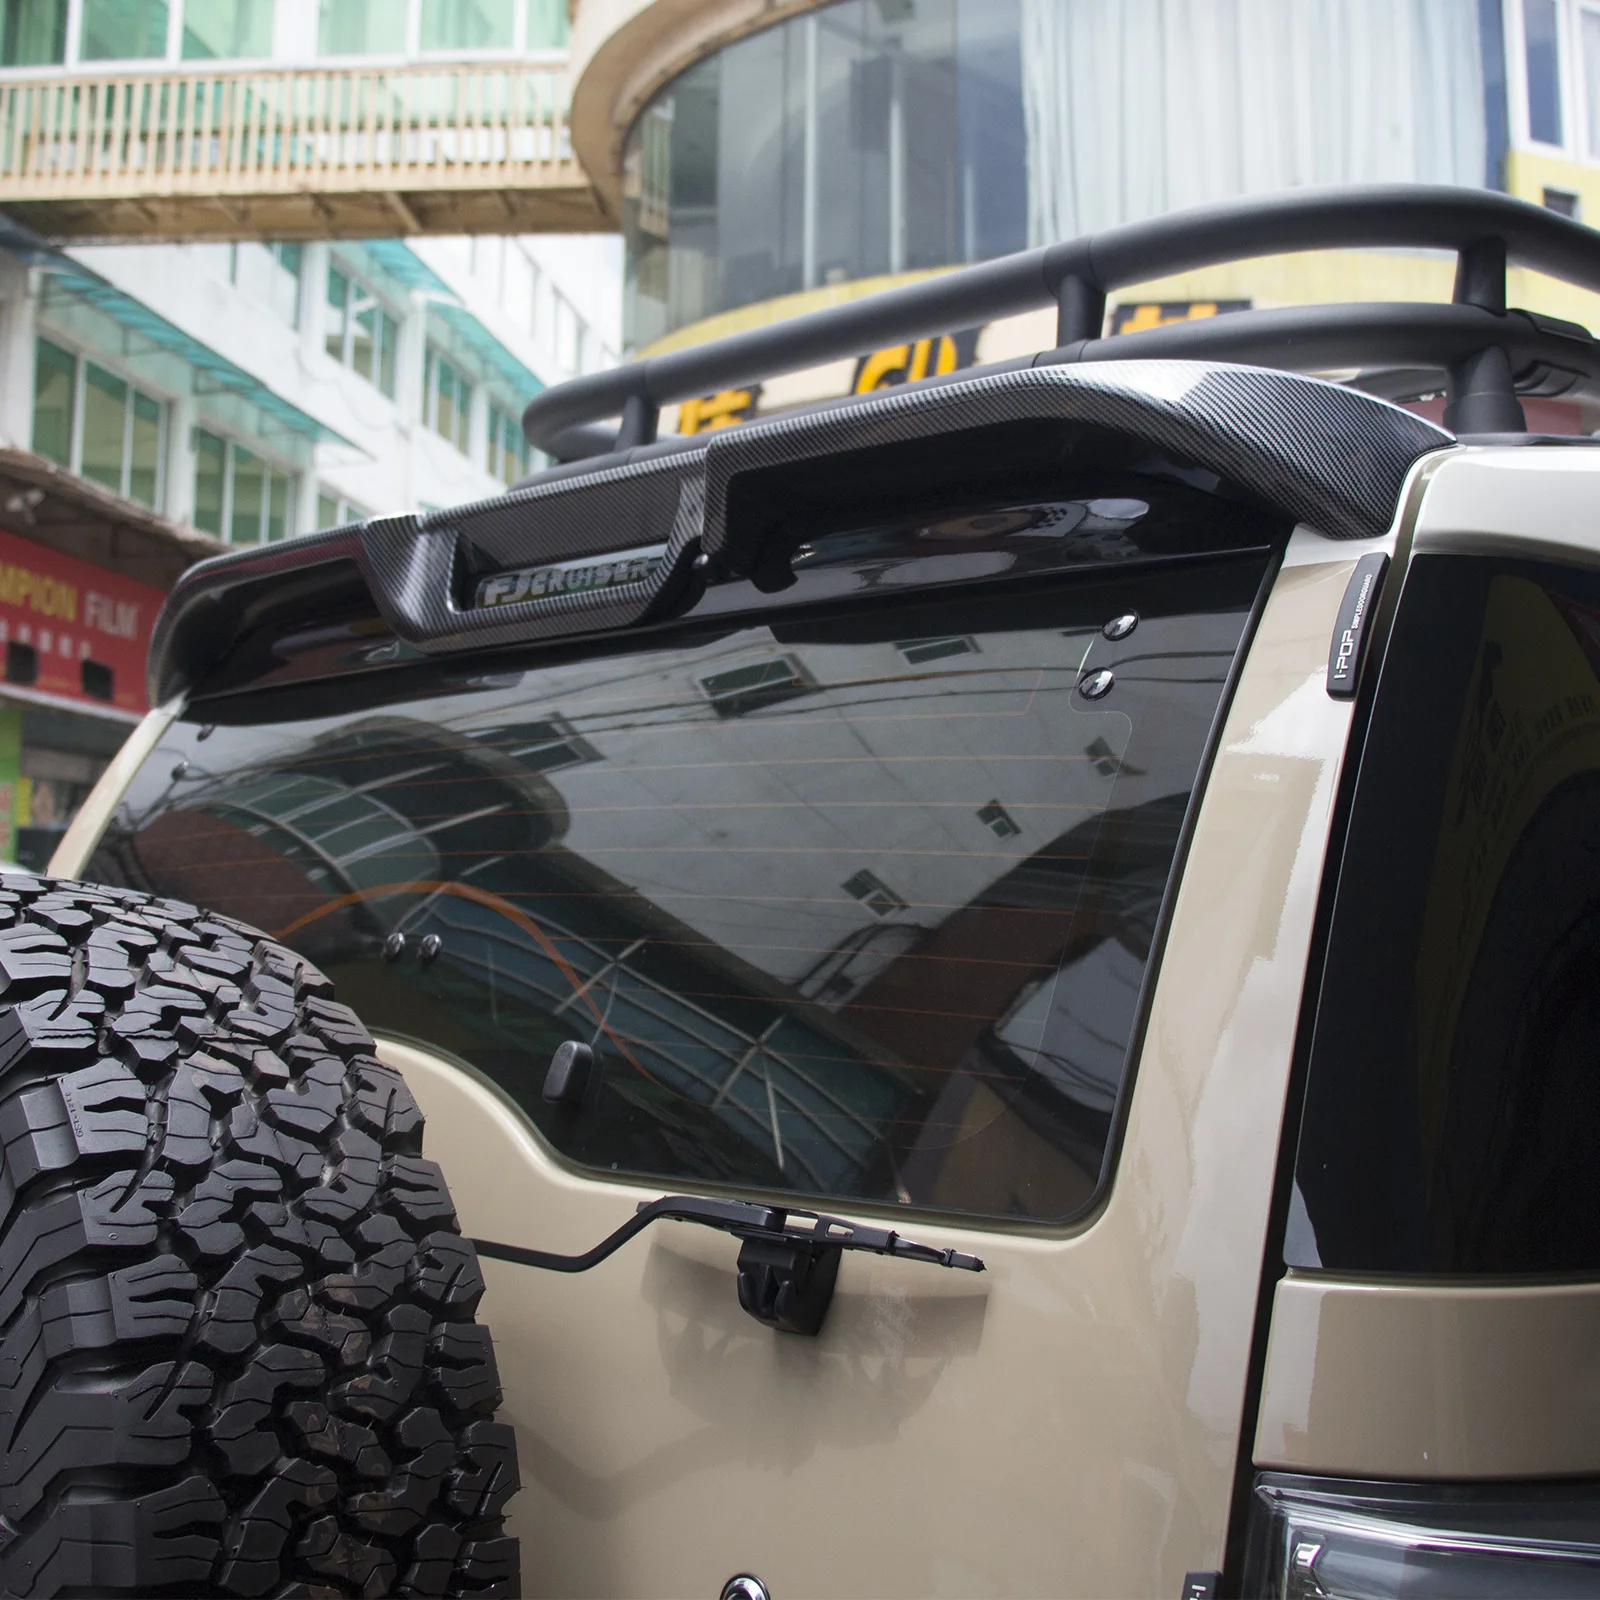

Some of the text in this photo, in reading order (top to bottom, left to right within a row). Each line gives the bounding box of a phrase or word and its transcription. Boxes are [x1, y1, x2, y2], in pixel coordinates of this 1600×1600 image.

[532, 556, 649, 595] CRUISER
[83, 589, 140, 641] FILM
[1333, 630, 1354, 680] I-POP
